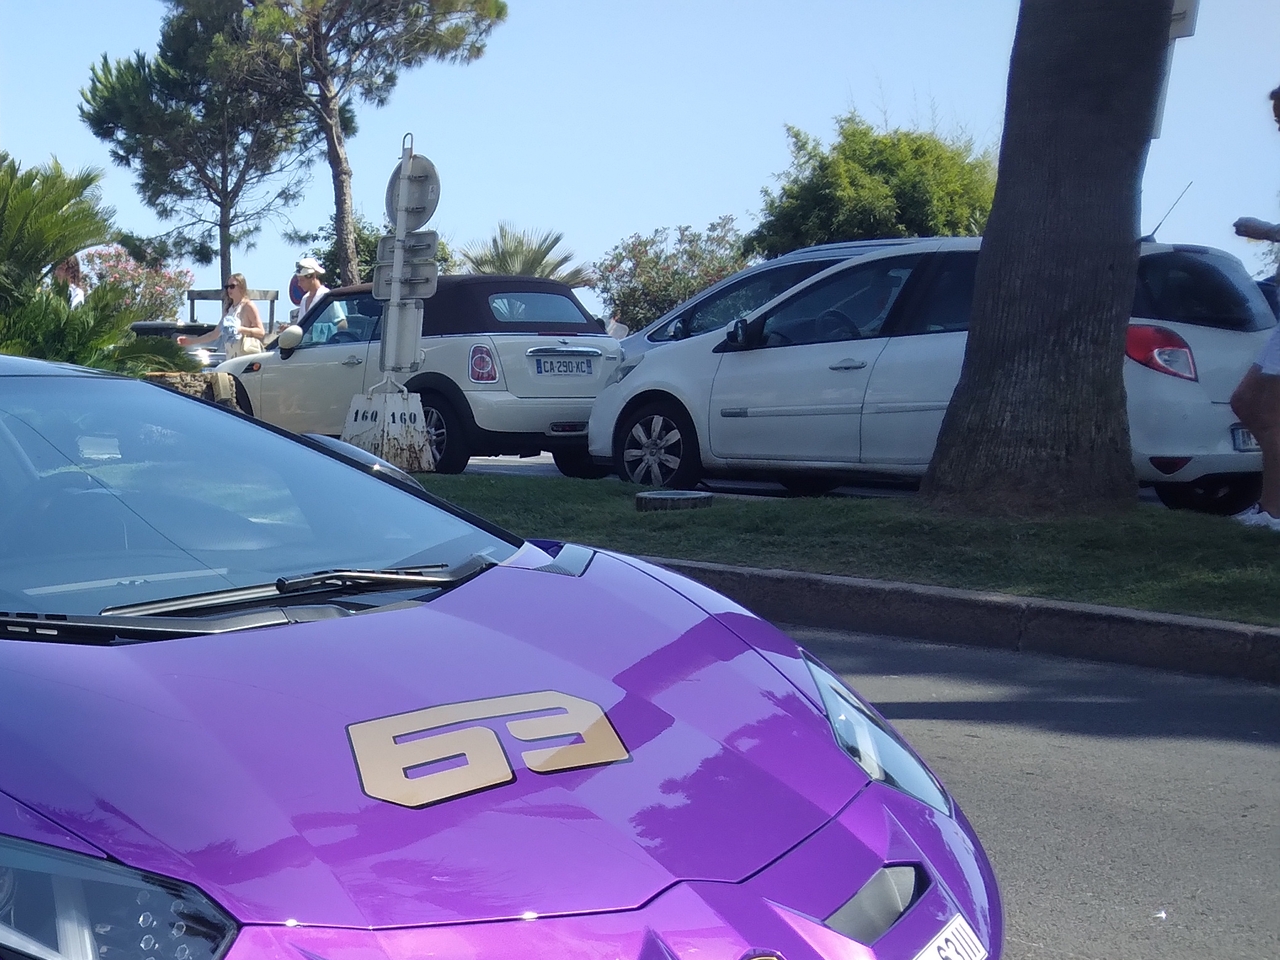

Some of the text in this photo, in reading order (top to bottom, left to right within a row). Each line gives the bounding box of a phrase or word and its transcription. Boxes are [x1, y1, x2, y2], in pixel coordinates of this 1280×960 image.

[543, 361, 586, 373] CA-290-XC
[353, 409, 378, 422] 160
[390, 412, 417, 424] 160
[345, 689, 633, 810] 63
